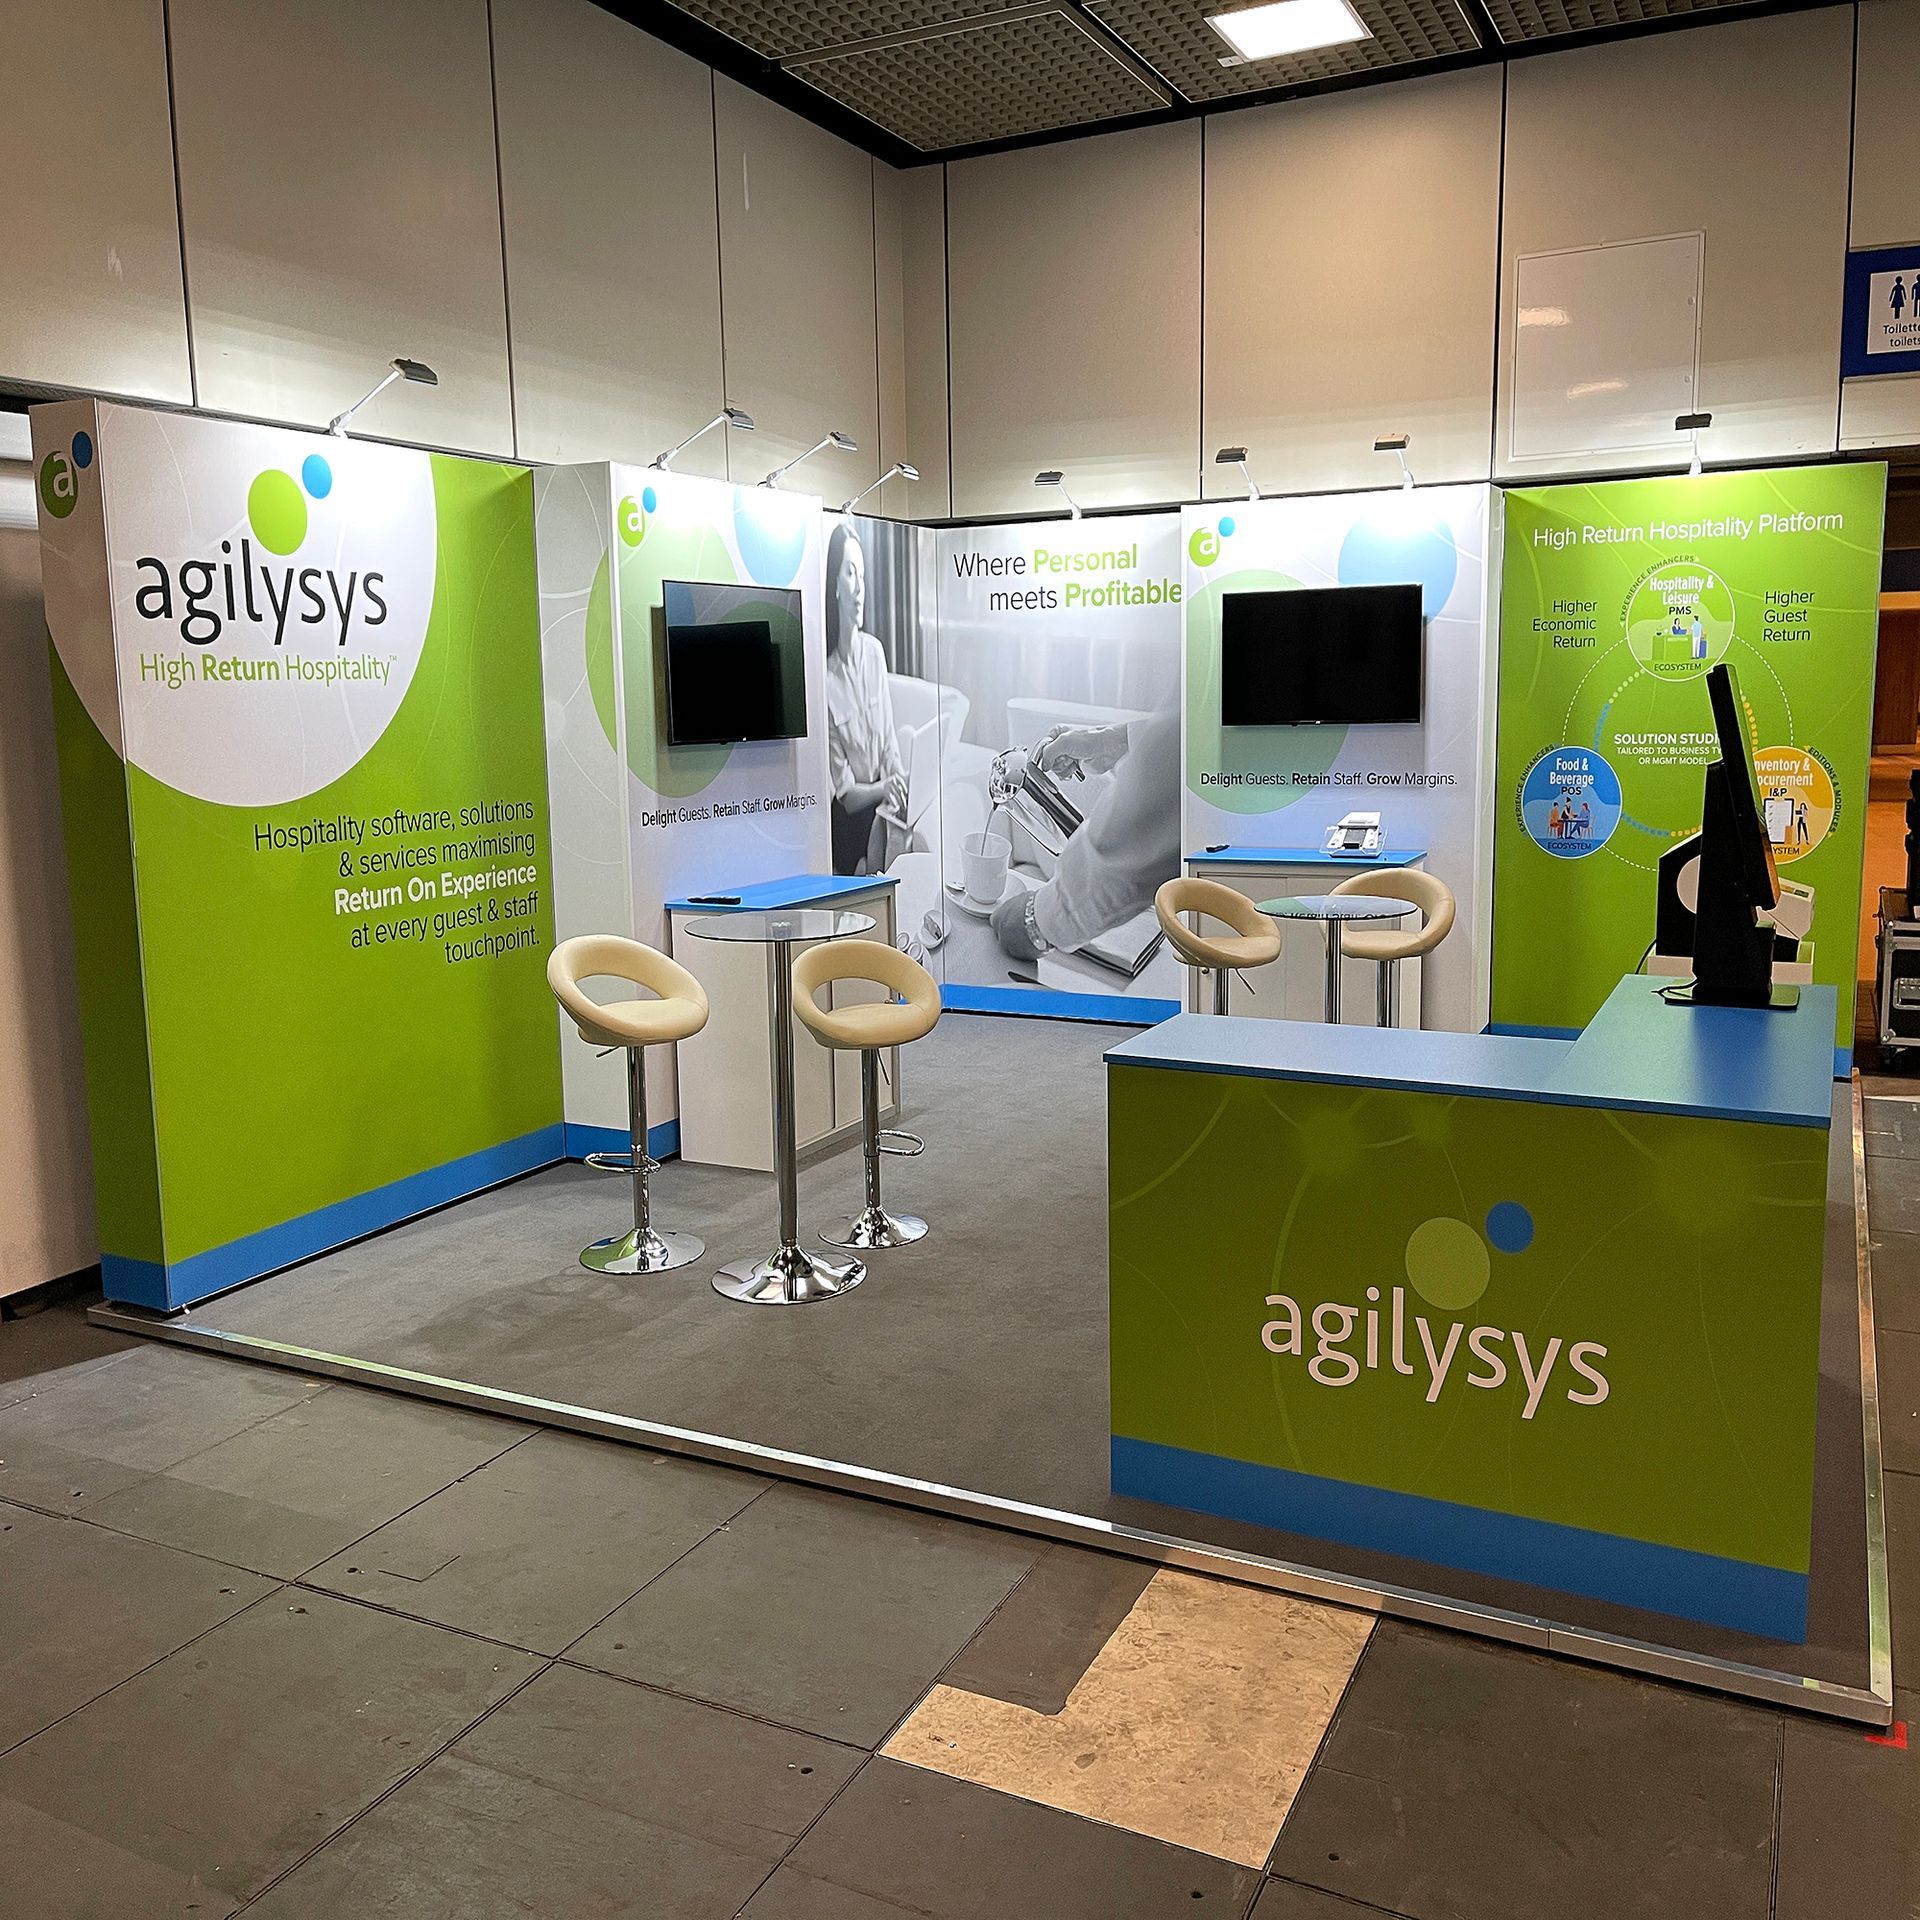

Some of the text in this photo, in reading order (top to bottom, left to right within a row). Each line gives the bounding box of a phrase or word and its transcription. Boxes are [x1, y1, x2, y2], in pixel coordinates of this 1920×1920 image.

[53, 452, 74, 497] a
[1534, 512, 1843, 550] High Return Hospitality Platform
[953, 543, 1138, 578] Where Personal
[1619, 555, 1695, 621] EXPERIENCE ENHANCERS
[1649, 574, 1714, 592] Hospitality &
[136, 538, 387, 646] agilysys
[990, 578, 1182, 611] meets Profitable
[1662, 591, 1699, 605] Leisure
[1765, 590, 1814, 607] Higher
[1553, 599, 1597, 616] Higher
[1668, 606, 1692, 615] PMS
[1532, 617, 1597, 632] Economic
[1764, 609, 1807, 624] Guest
[1553, 635, 1596, 649] Return
[1763, 628, 1811, 642] Return
[140, 652, 196, 690] High
[201, 653, 280, 682] Return
[1654, 663, 1702, 671] ECOSYSTEM
[1614, 733, 1719, 745] SOLUTION STUDI
[1617, 746, 1722, 755] TAILORED TO BUSINESS TY
[1556, 757, 1589, 771] Food &
[1638, 757, 1707, 765] OR MGMT MODEL
[1754, 757, 1811, 774] nventory &
[1200, 771, 1458, 788] Delight Guests. Retain Staff. Grow Margins.
[1515, 743, 1555, 832] EXPERIENCE ENHANCERS
[1549, 771, 1595, 787] Beverage
[1757, 773, 1814, 786] ocurement
[1561, 786, 1582, 795] POS
[1769, 788, 1787, 796] I&P
[1808, 747, 1837, 779] EDITIONS
[1829, 789, 1842, 832] MODULES
[641, 793, 818, 829] Delight Guests. Retain Staff. Grow Margins.
[254, 800, 534, 852] Hospitality software, solutions
[339, 831, 535, 877] & services maximising
[1547, 841, 1592, 850] ECOSYSTEM
[1773, 846, 1800, 855] YSTEM
[334, 864, 537, 915] Return On Experience
[351, 891, 539, 948] at every guest & staff
[444, 926, 541, 964] touchpoint.
[1259, 1285, 1611, 1420] agilysys
